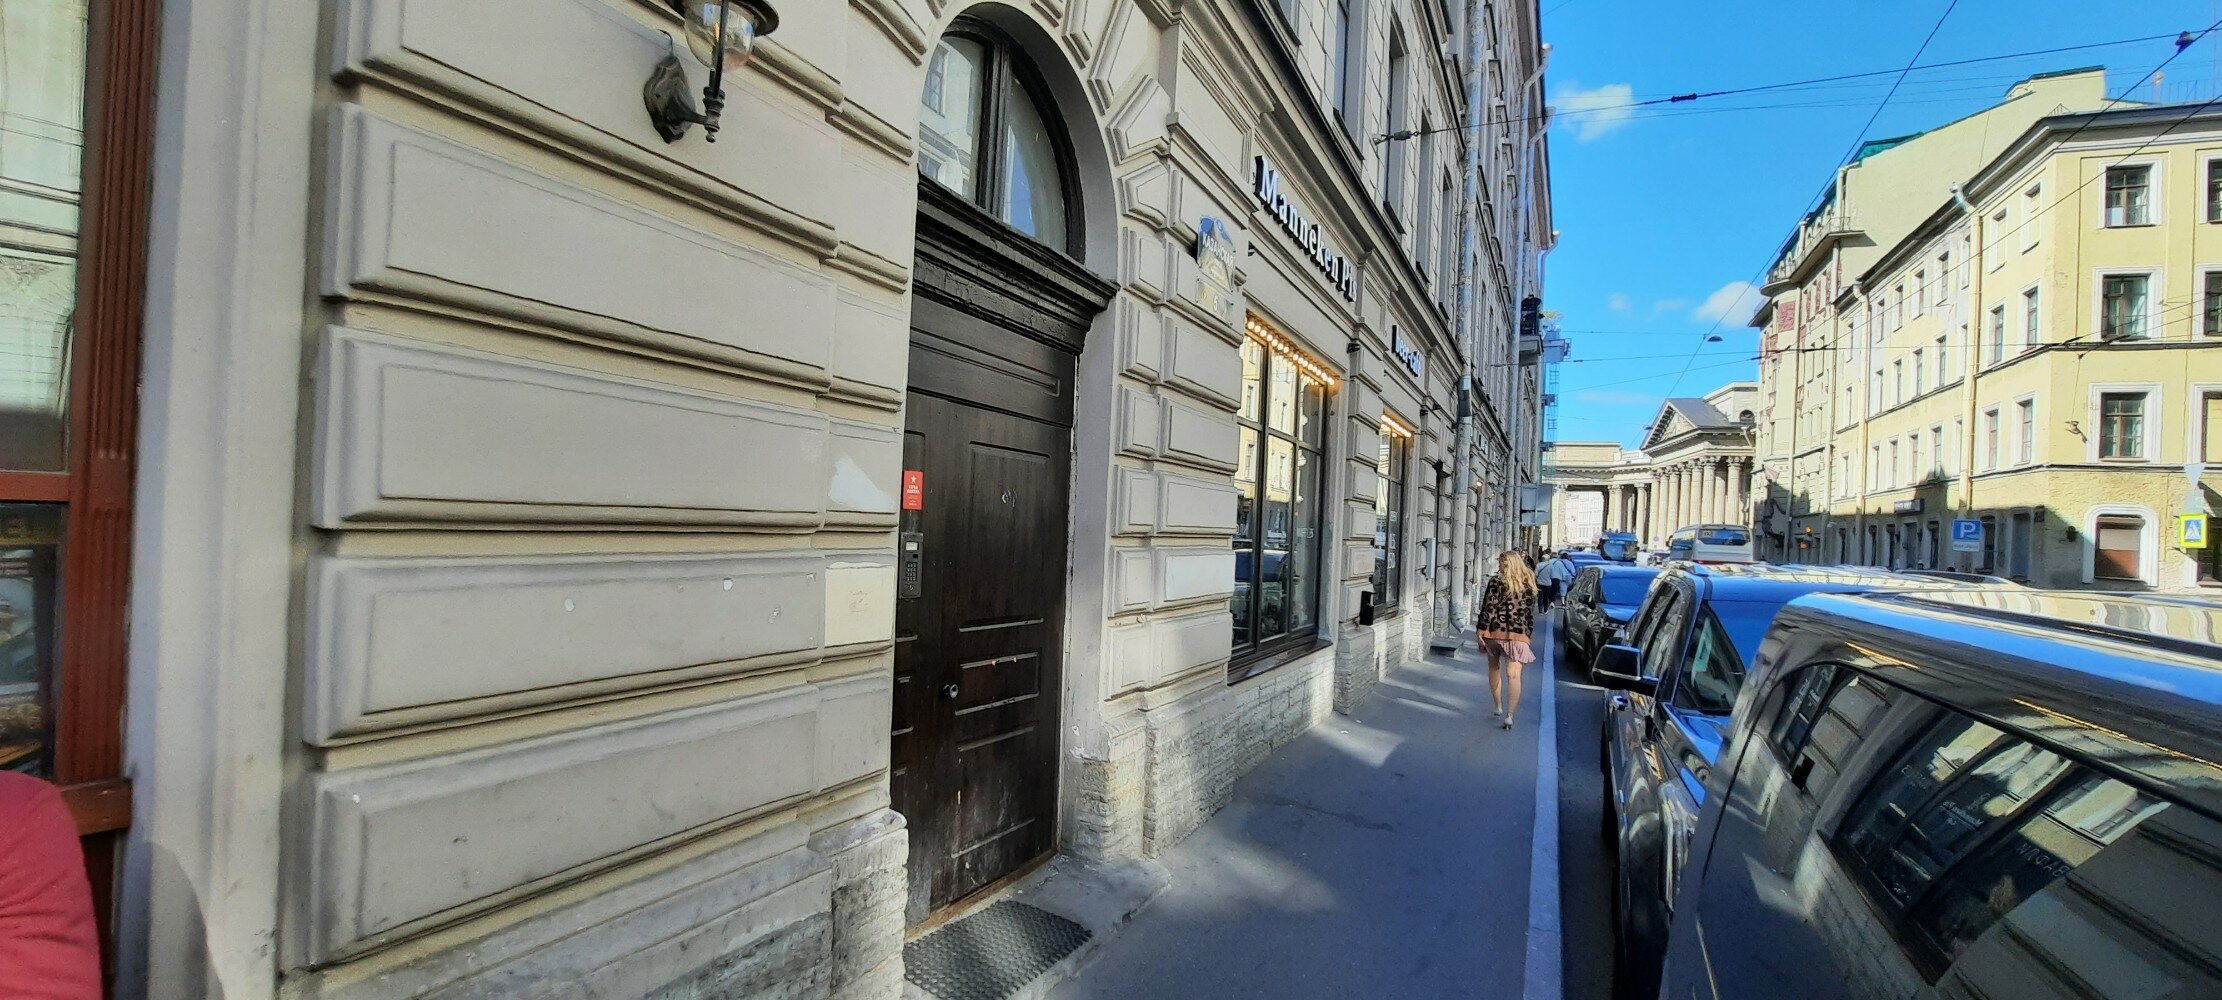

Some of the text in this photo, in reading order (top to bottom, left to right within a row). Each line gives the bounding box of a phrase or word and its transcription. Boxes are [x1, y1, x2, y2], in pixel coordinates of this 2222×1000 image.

[1202, 231, 1234, 269] КАЗАНСКАЯ
[1256, 155, 1357, 302] Manneken Pis
